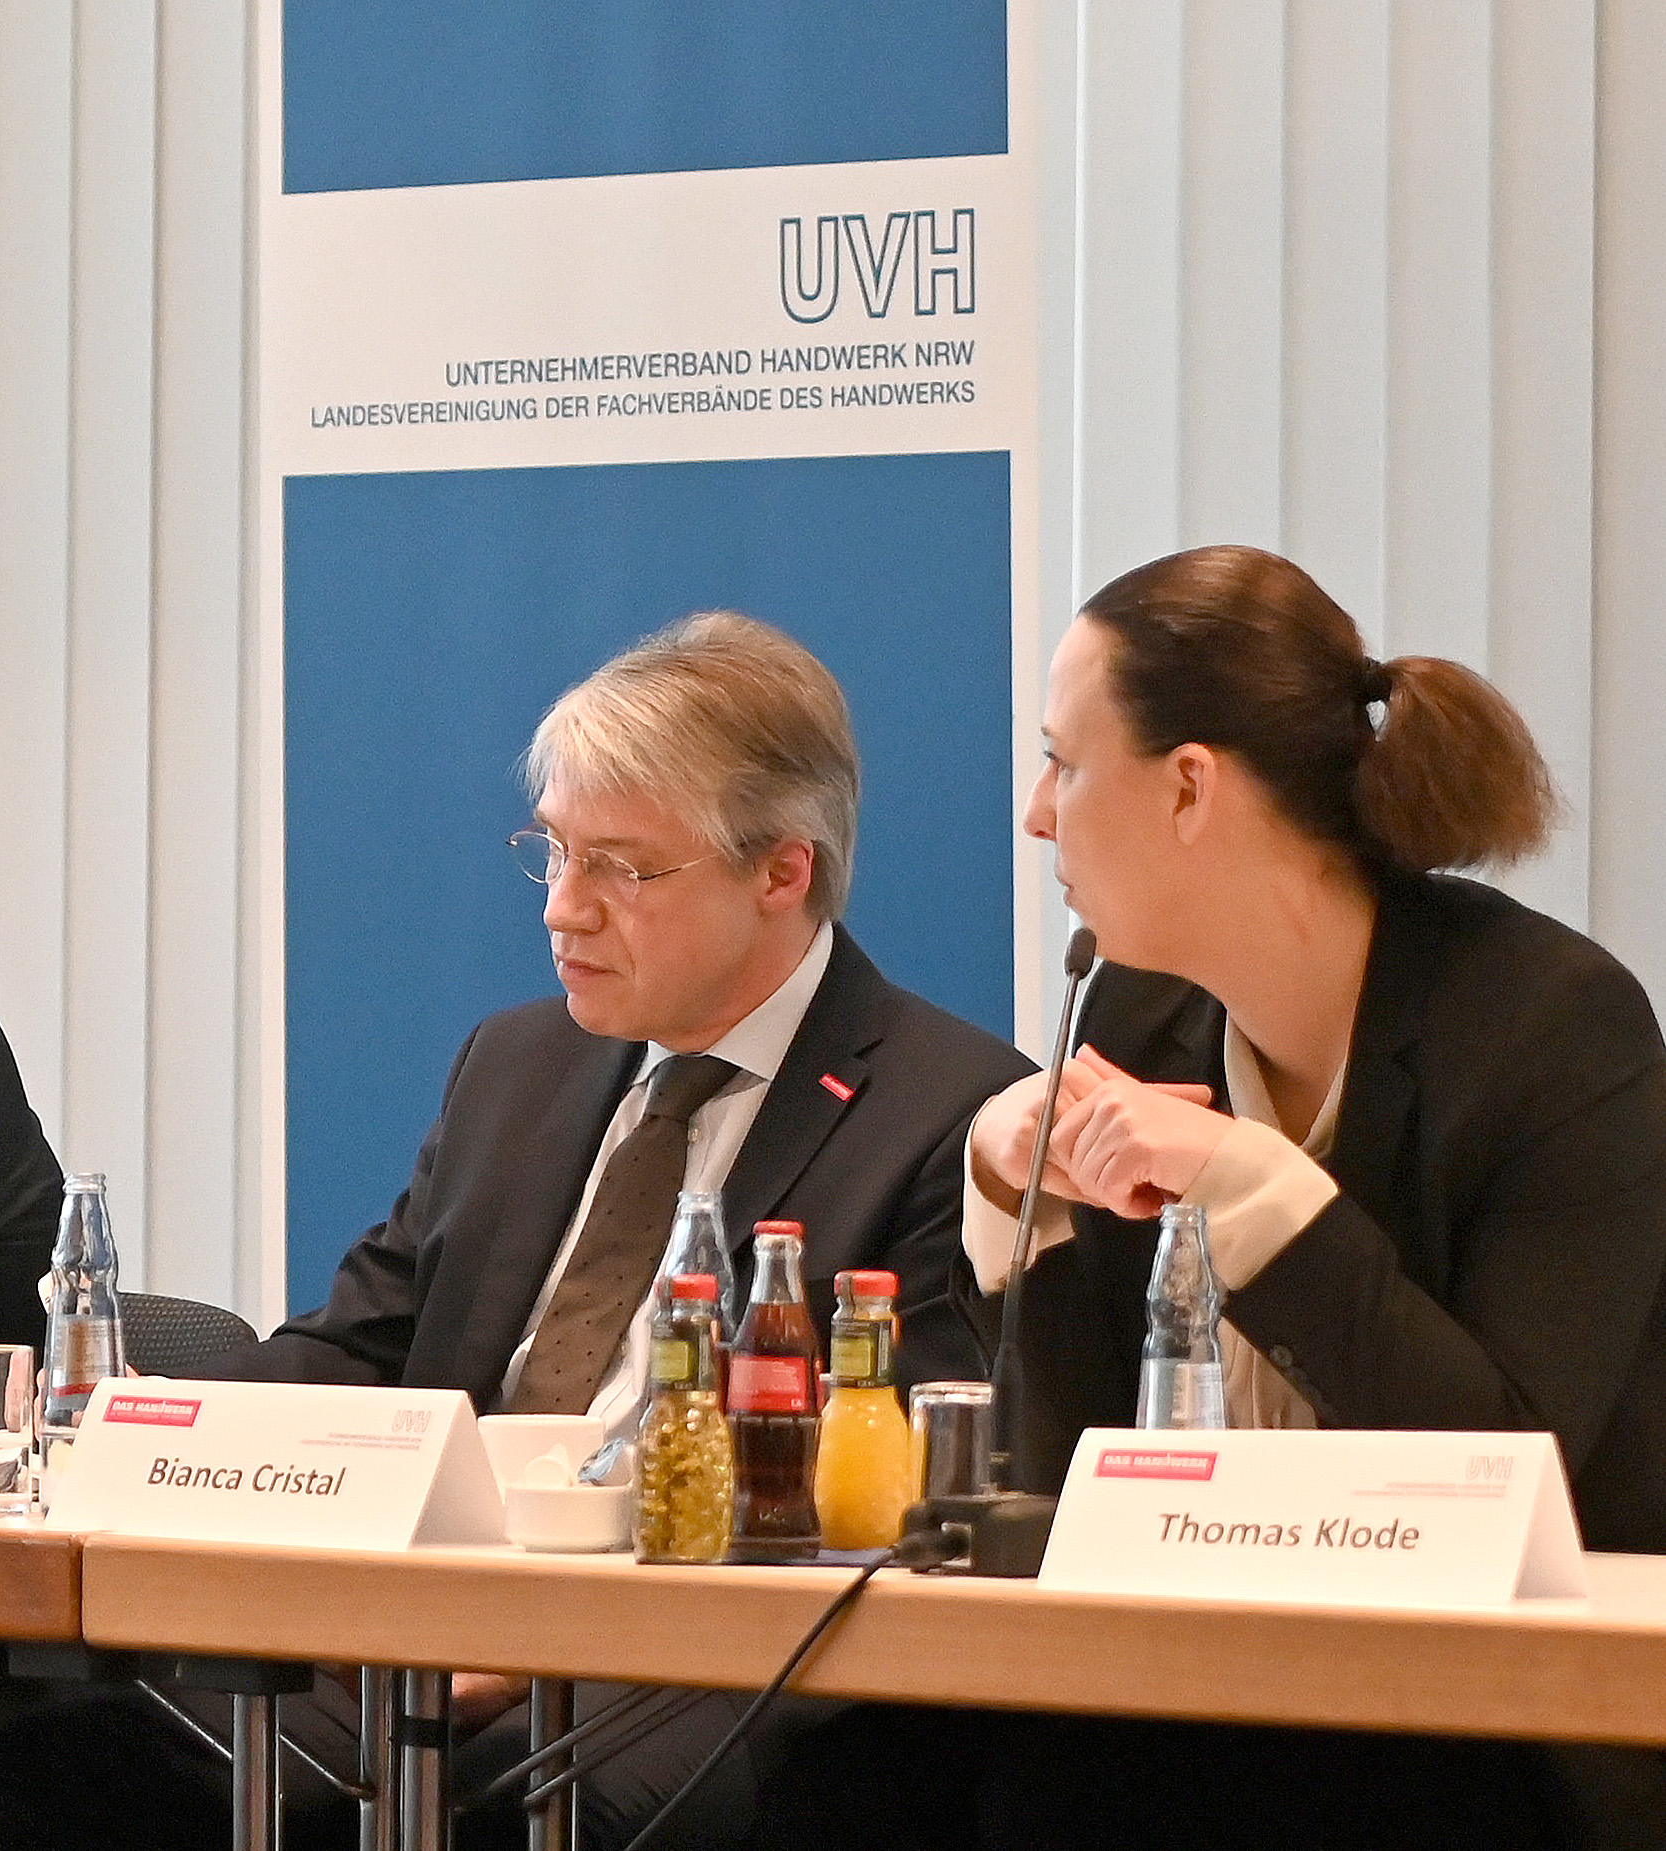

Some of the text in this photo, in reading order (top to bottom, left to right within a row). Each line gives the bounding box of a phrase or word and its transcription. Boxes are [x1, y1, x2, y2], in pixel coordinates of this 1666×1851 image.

[779, 207, 976, 325] UVH
[445, 339, 976, 388] UNTERNEHMERVERBAND HANDWERK NRW
[310, 380, 975, 429] LANDESVEREINIGUNG DER FACHVERBÄNDE DES HANDWERKS
[147, 1457, 347, 1496] Bianca Cristal
[1465, 1455, 1515, 1480] UVH
[1161, 1513, 1420, 1550] Thomas Klode
